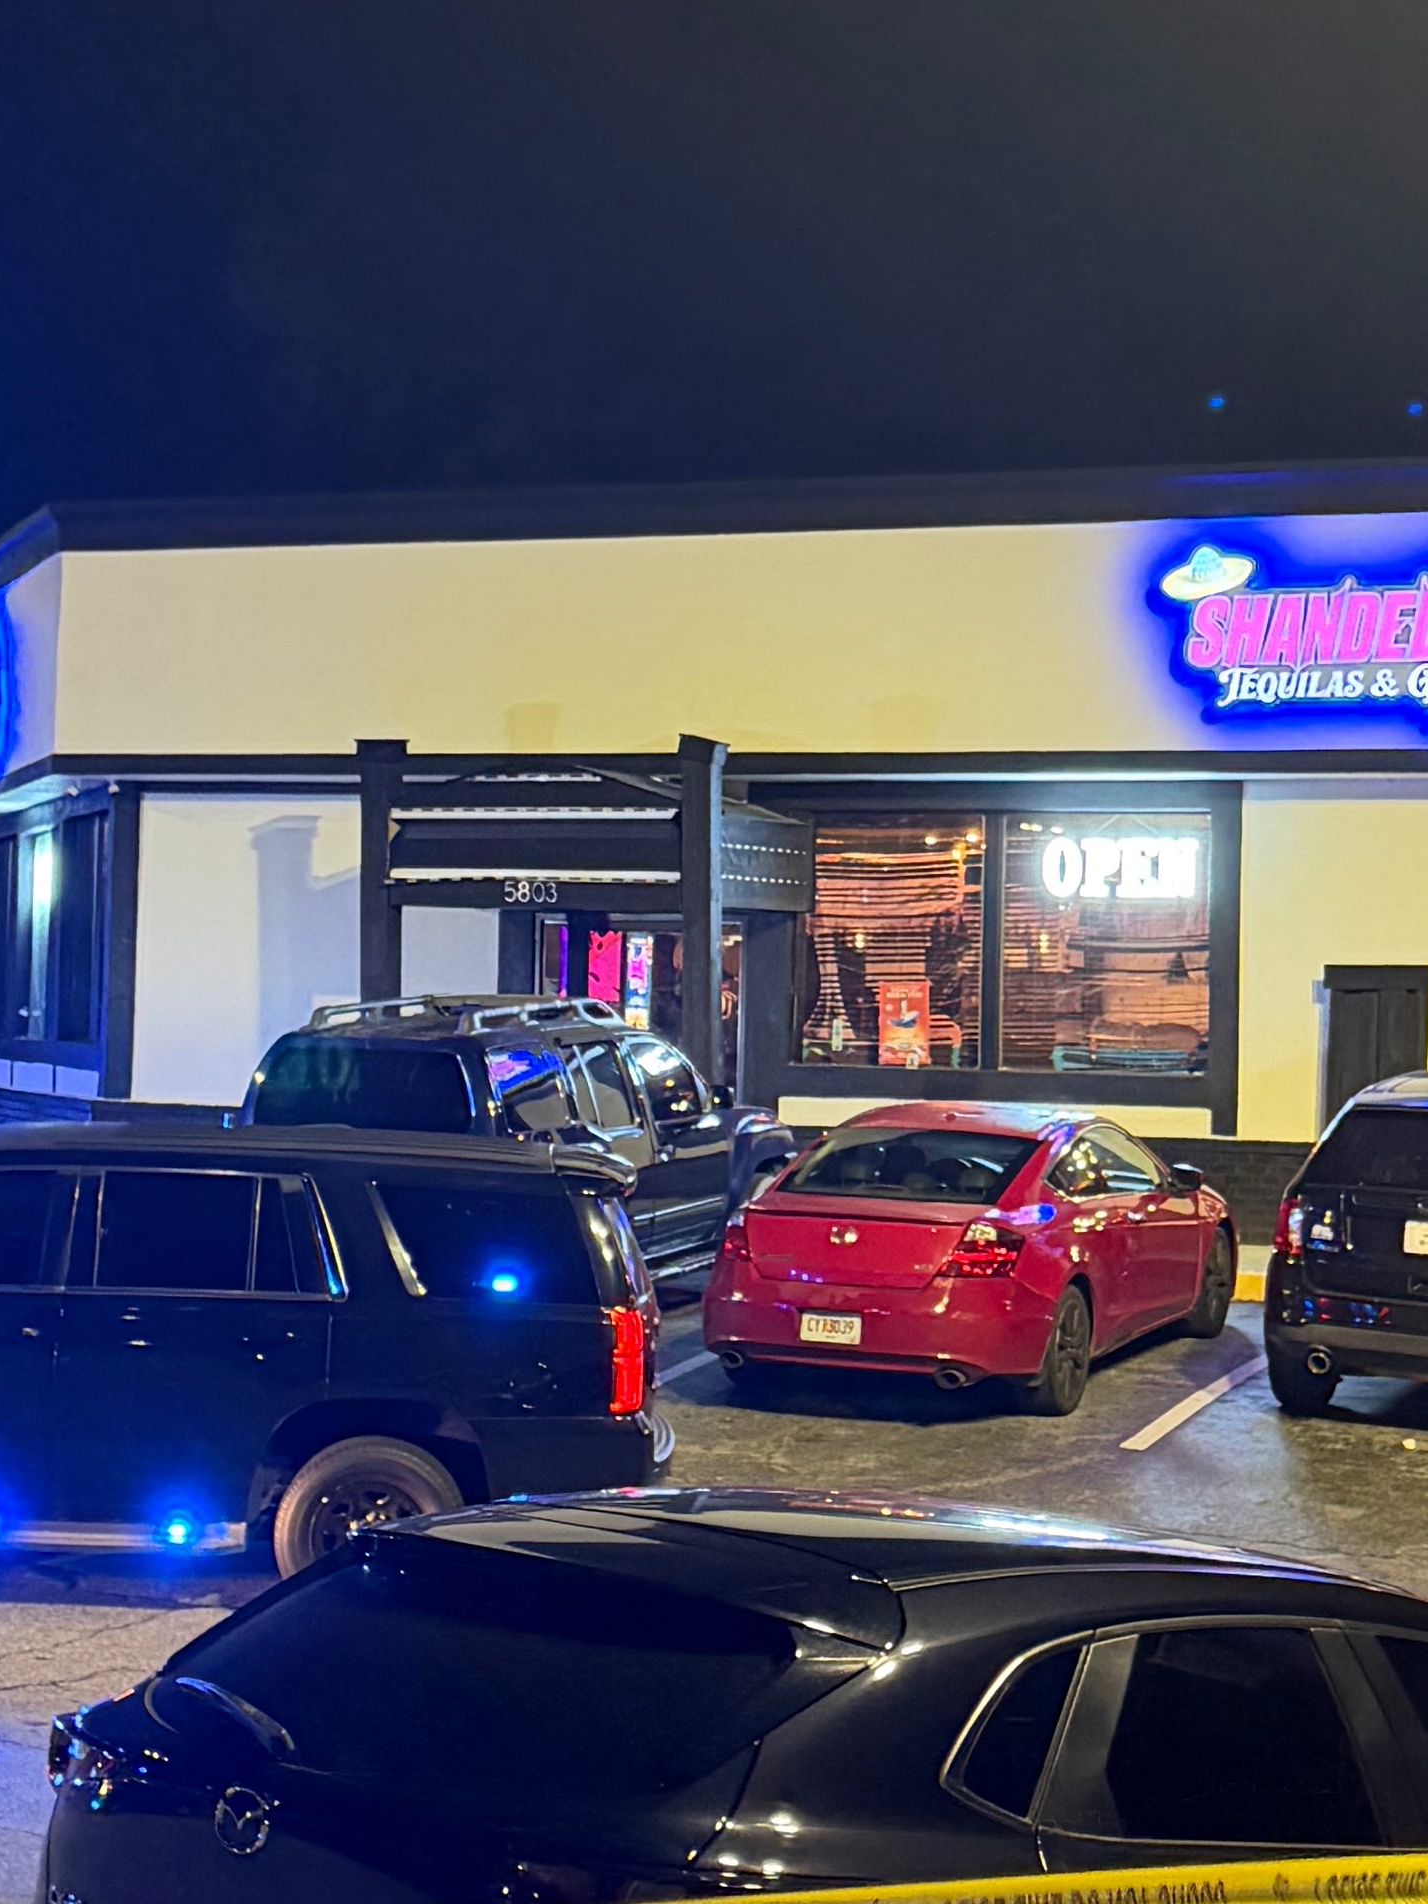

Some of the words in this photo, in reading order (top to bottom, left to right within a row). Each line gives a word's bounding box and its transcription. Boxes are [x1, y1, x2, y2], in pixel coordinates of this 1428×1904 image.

[1370, 668, 1399, 697] &
[1042, 837, 1200, 898] OPEN
[504, 880, 558, 903] 5803
